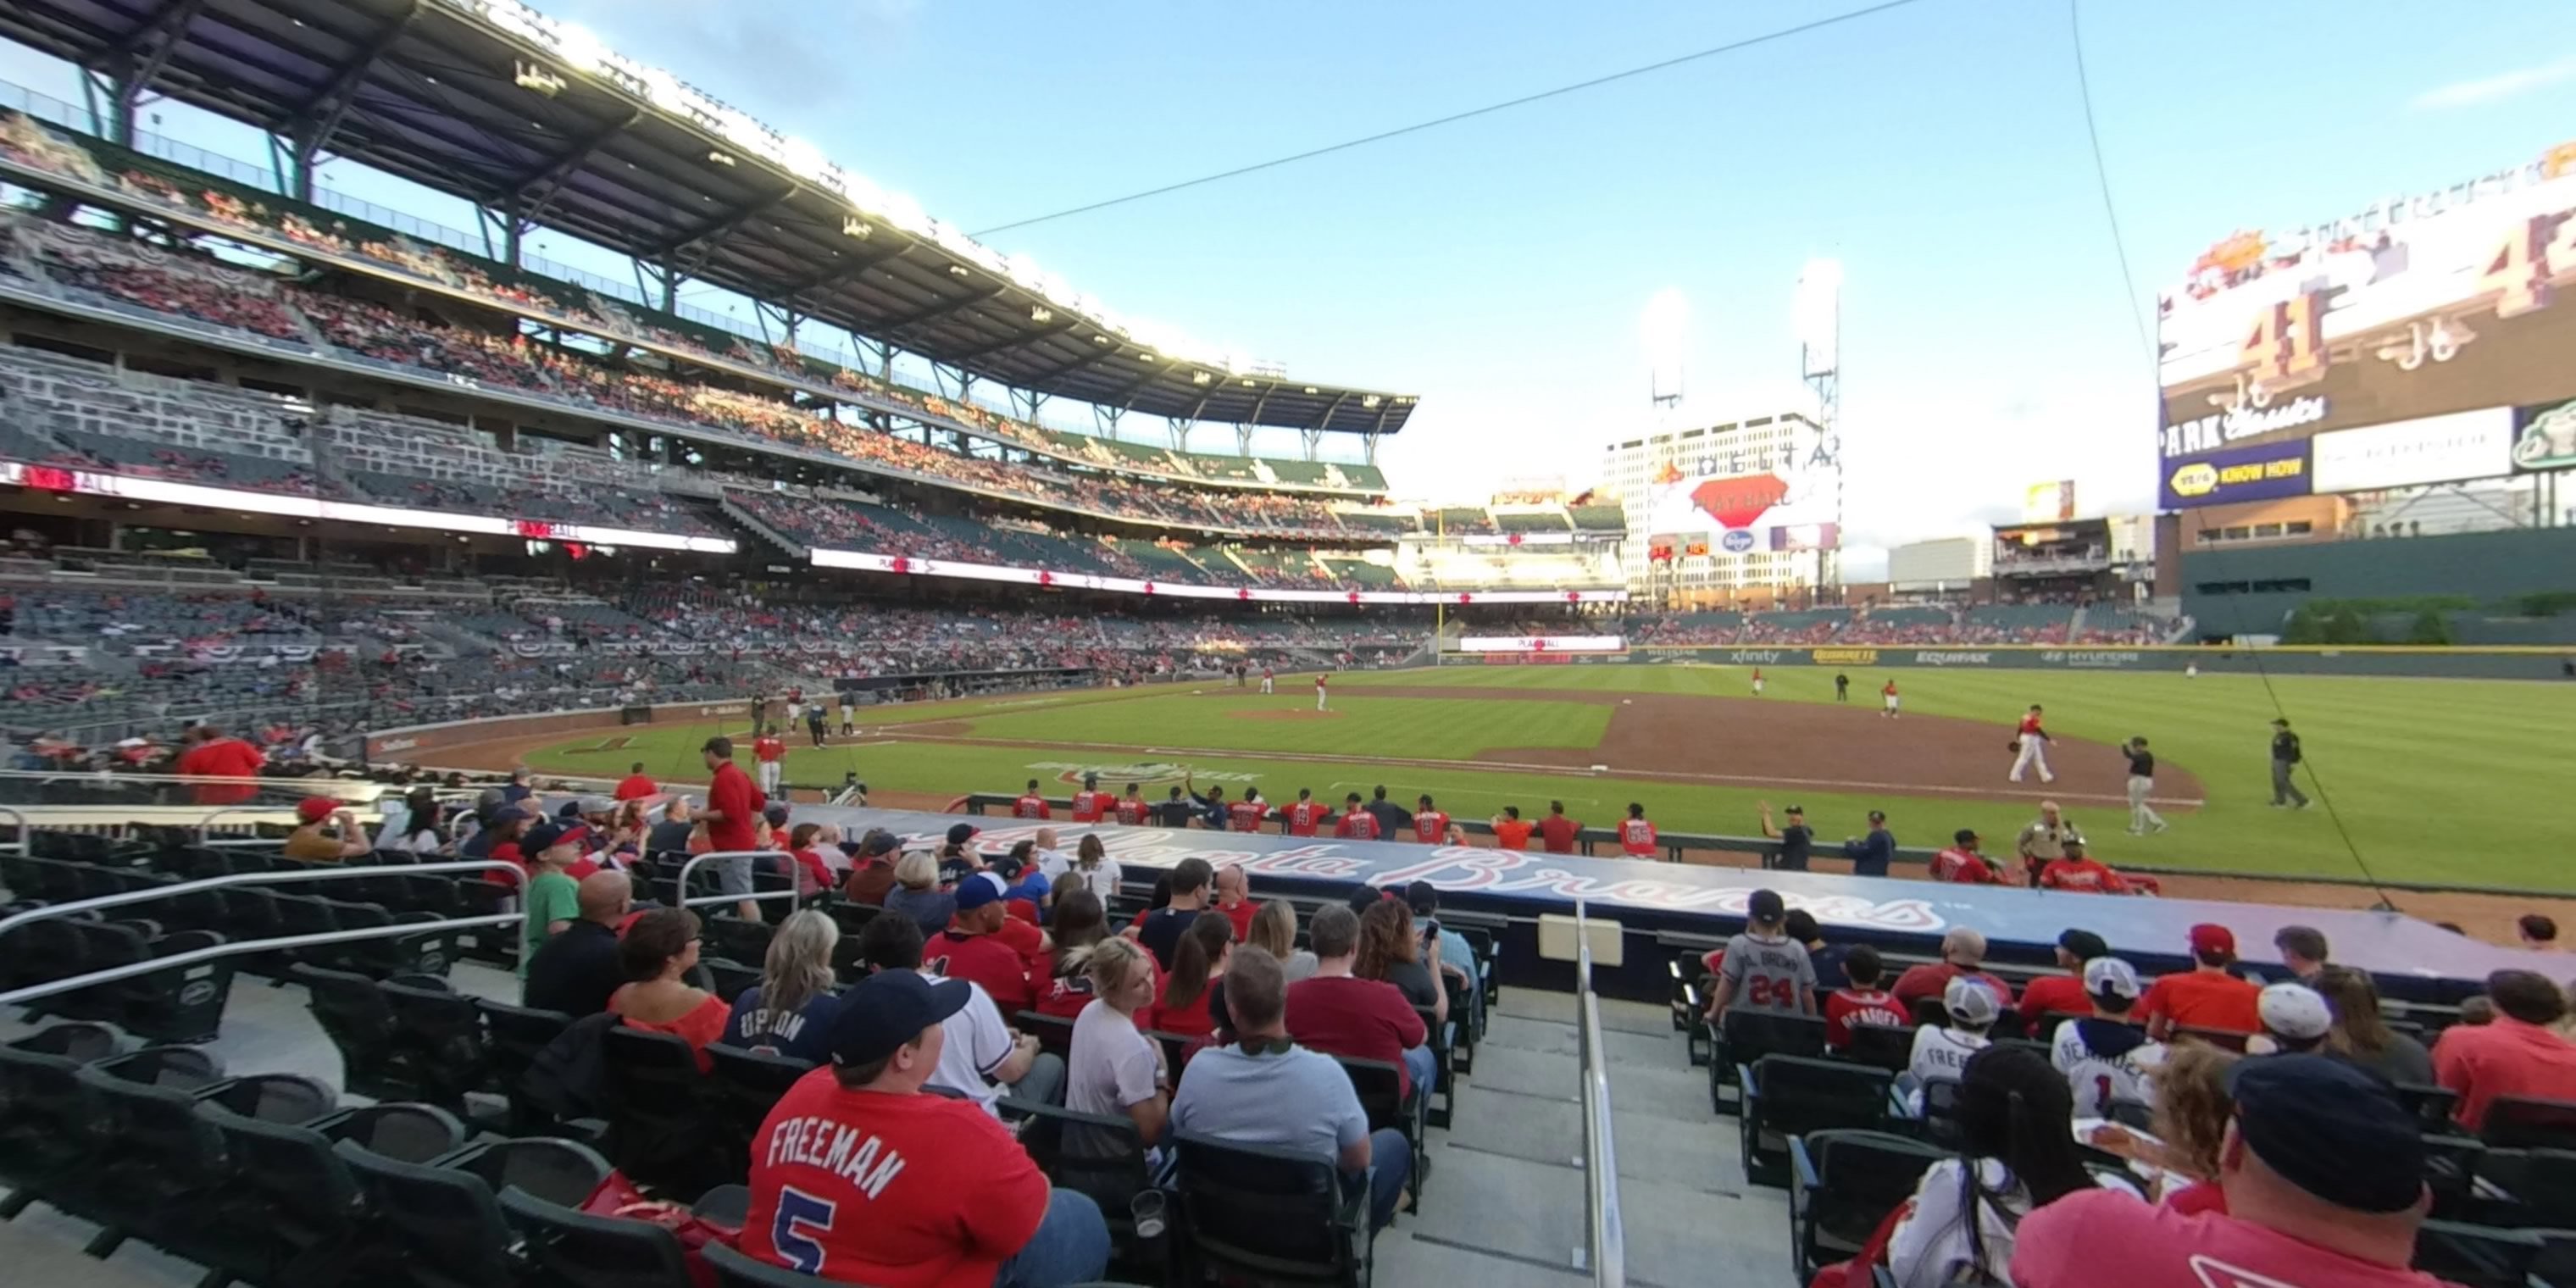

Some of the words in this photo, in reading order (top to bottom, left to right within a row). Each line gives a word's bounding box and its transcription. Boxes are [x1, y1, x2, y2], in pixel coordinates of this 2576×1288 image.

[2238, 292, 2327, 385] 41
[2220, 464, 2264, 485] KNOW
[2265, 458, 2303, 480] HOW
[1730, 649, 1780, 663] xfinity
[1915, 651, 1991, 665] EQUIFAX
[2068, 652, 2139, 662] HYUNDAI
[1420, 817, 1434, 836] 8
[1364, 846, 1946, 932] Braves
[1748, 974, 1795, 1008] 24
[740, 1008, 806, 1042] UPON
[2094, 1074, 2112, 1112] 1
[766, 1117, 906, 1201] FREEMAN
[771, 1184, 837, 1274] 5
